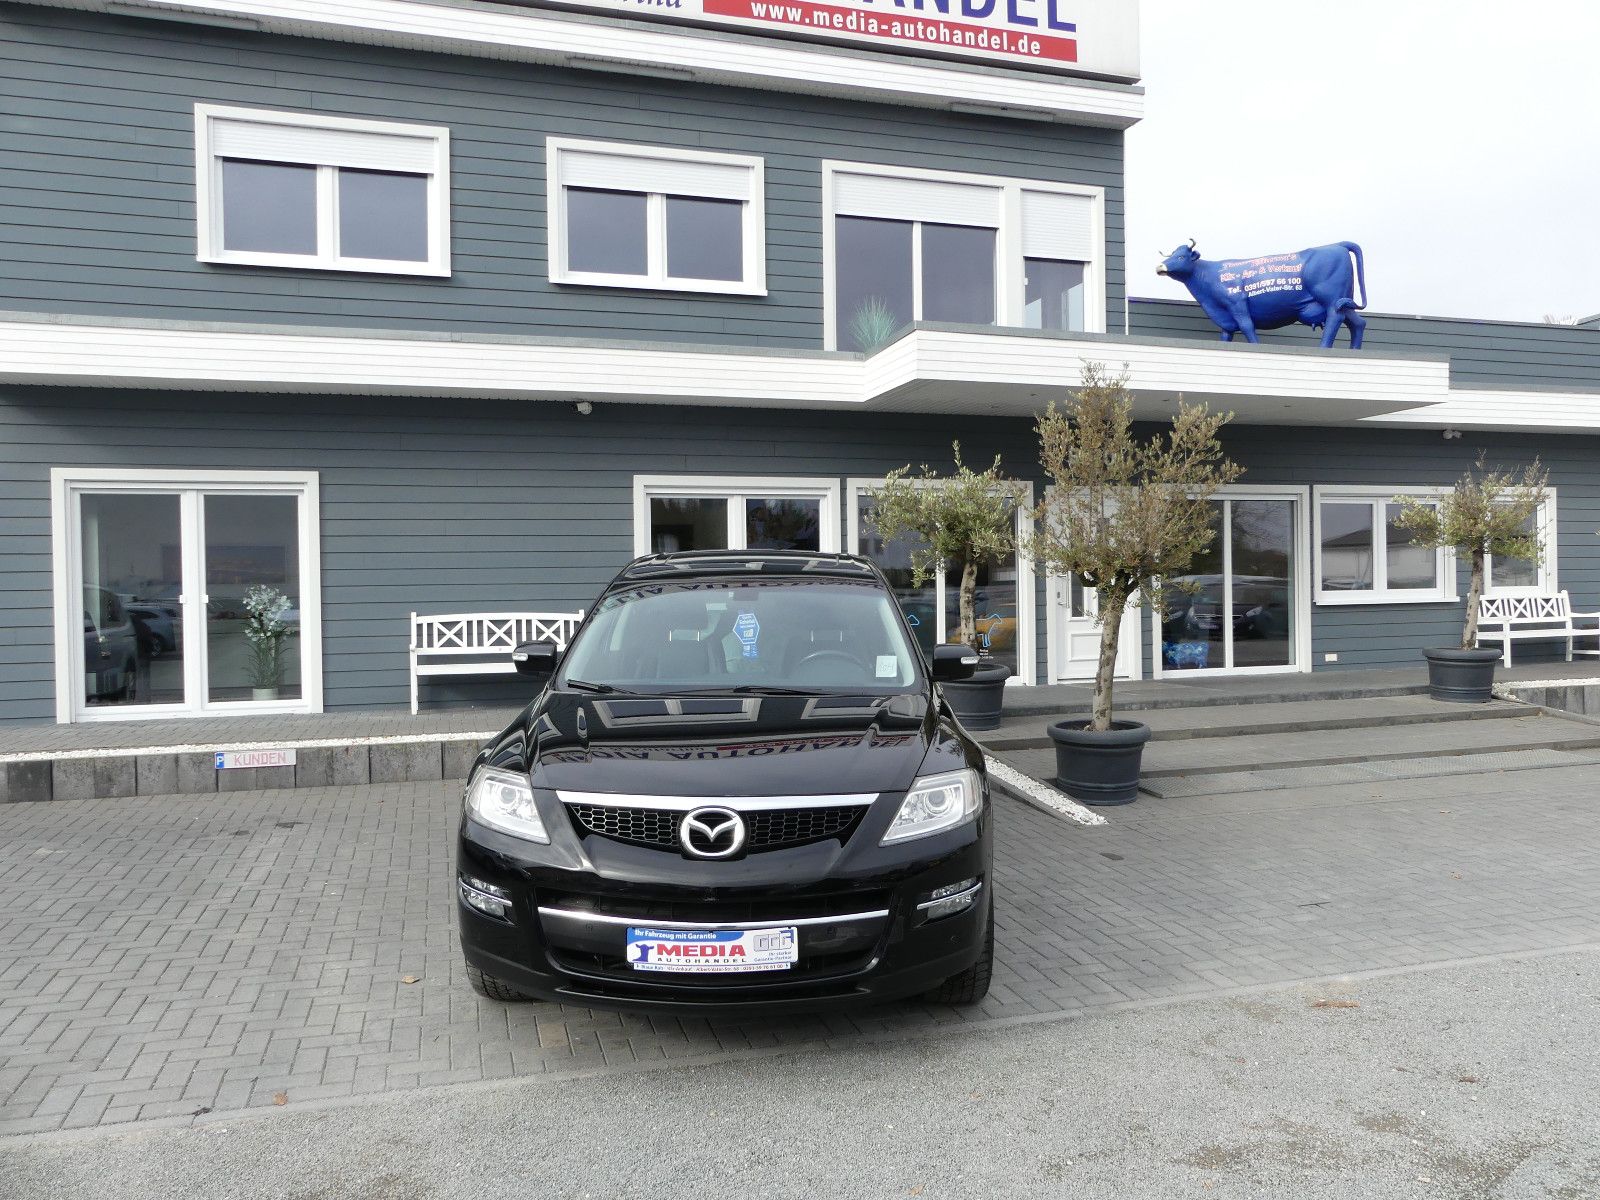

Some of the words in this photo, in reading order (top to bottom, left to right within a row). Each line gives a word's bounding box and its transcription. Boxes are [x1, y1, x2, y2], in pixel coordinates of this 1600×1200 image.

[751, 2, 1041, 54] www.media-autohandel.de
[1228, 286, 1242, 294] Tel.
[216, 755, 223, 765] P
[233, 752, 287, 767] KUNDEN
[645, 931, 674, 940] Fahrzeug
[656, 944, 746, 957] MEDIA
